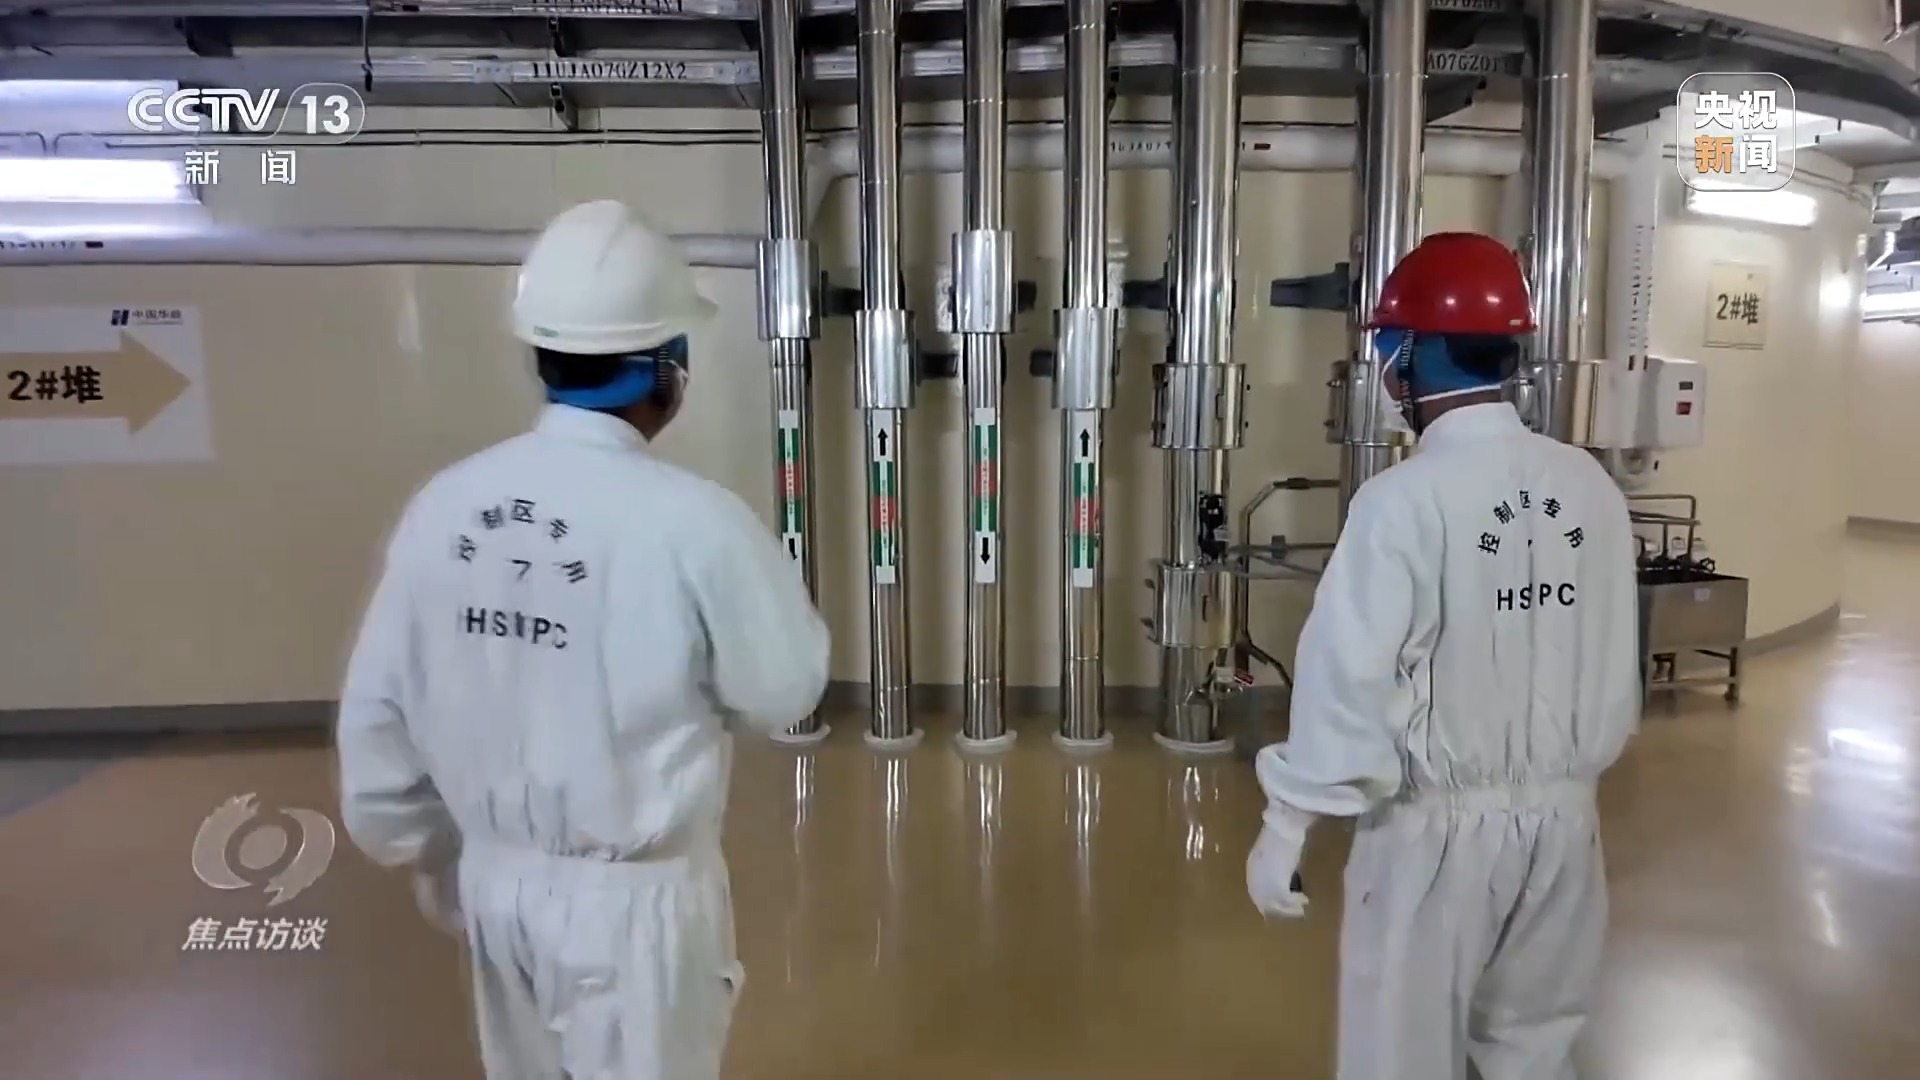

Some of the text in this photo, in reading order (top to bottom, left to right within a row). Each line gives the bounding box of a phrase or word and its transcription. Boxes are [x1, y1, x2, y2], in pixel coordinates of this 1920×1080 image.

[1716, 293, 1760, 325] 2#堆
[7, 365, 104, 403] 2#堆
[1478, 490, 1585, 556] 控制区专用
